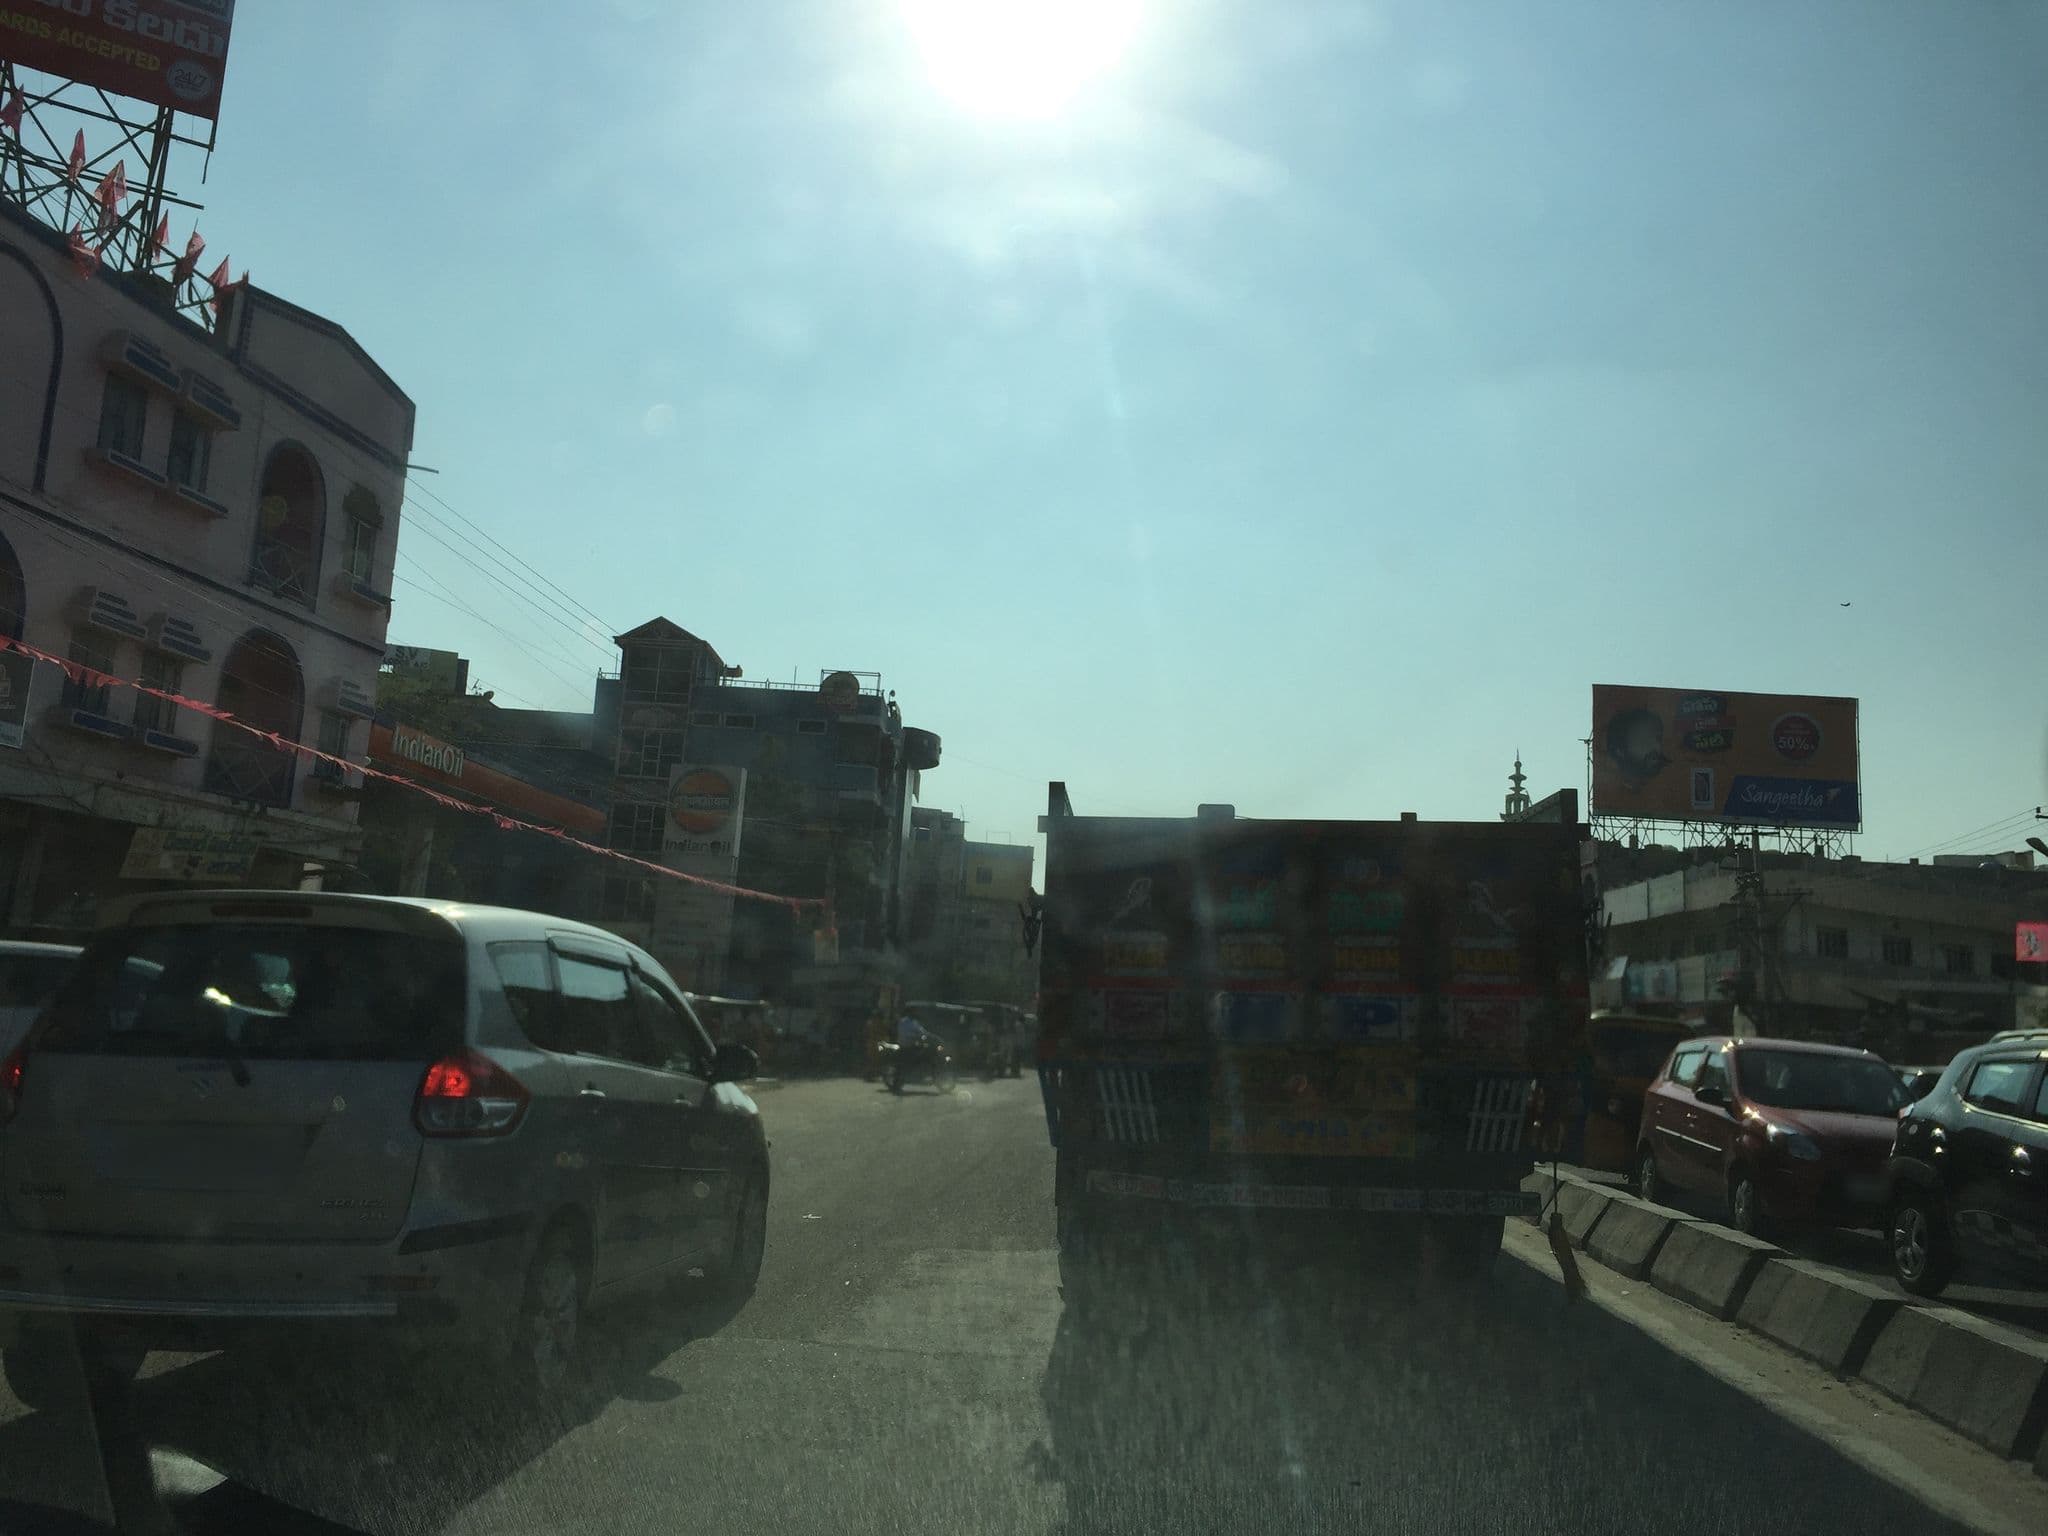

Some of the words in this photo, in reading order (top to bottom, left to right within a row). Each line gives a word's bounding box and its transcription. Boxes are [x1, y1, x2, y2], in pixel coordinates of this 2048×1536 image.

[56, 25, 160, 71] ACCEPTED
[392, 725, 465, 777] IndianOil
[1740, 783, 1826, 813] Sangeetha
